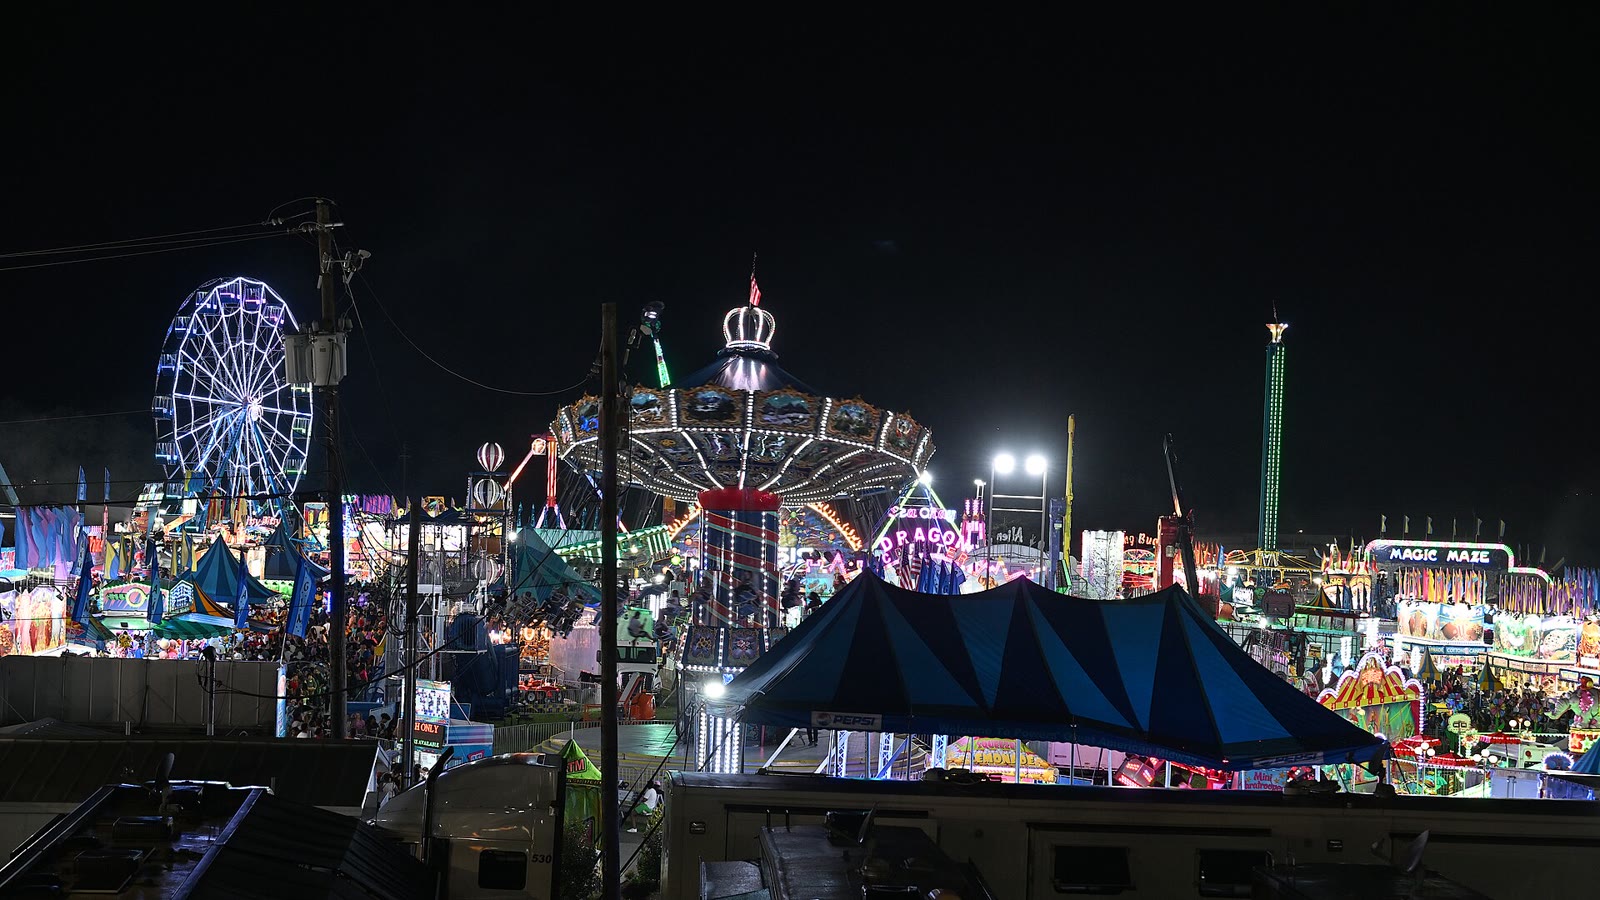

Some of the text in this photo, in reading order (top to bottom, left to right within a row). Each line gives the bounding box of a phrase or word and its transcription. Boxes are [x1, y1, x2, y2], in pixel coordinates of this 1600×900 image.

[1390, 548, 1490, 563] MAGIC MAZE
[833, 715, 876, 726] PEPSI
[420, 723, 440, 734] ONLY
[566, 758, 585, 773] TM
[1254, 771, 1273, 782] Mini
[532, 854, 553, 864] 530
